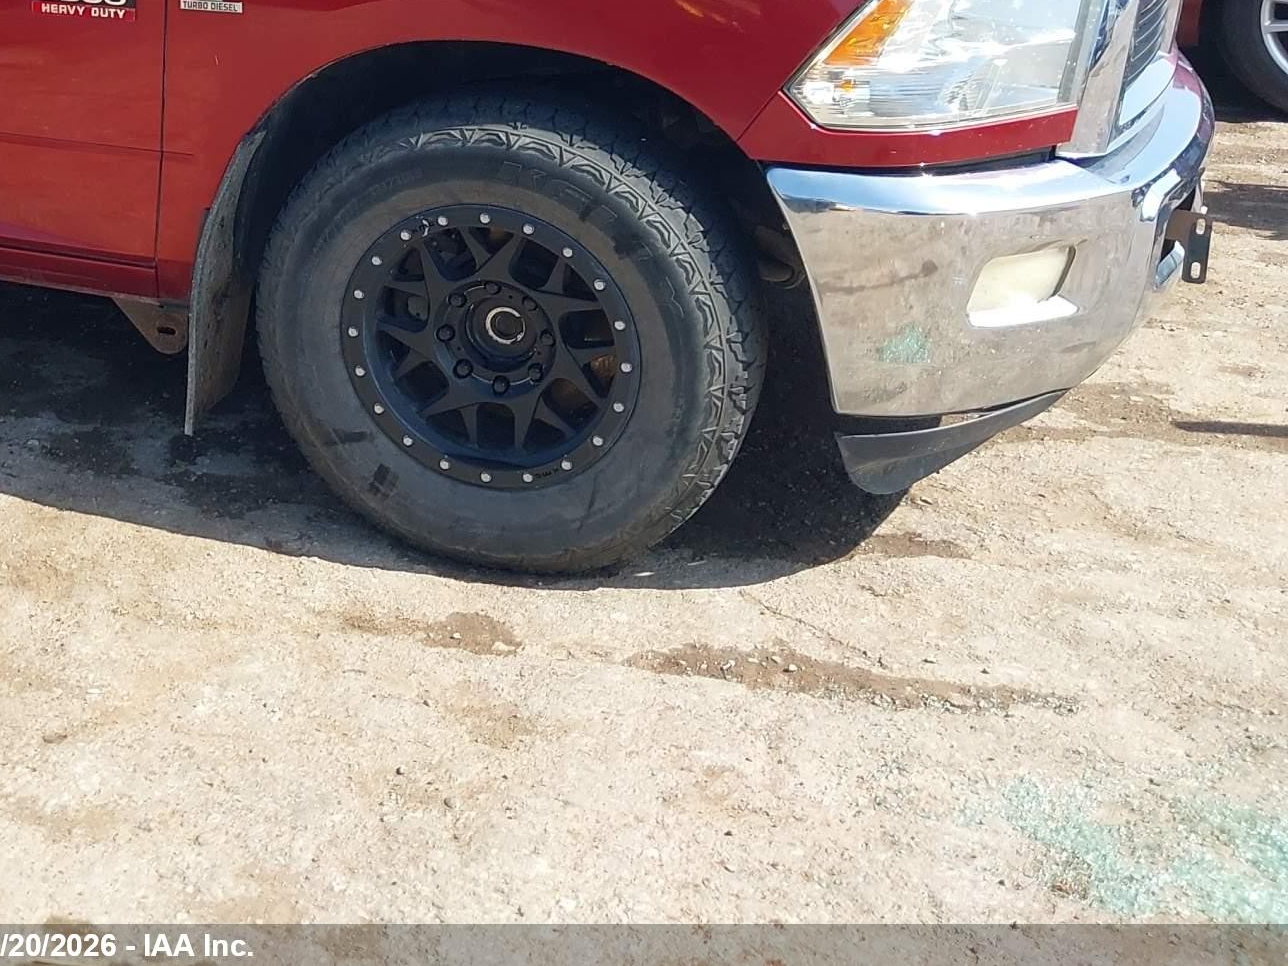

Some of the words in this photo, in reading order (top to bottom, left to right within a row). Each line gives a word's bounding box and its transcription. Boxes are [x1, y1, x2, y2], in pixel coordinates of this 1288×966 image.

[41, 3, 85, 16] HEAVY
[91, 7, 126, 19] DUTY
[183, 0, 209, 10] TURBO
[210, 2, 239, 12] DIESEL
